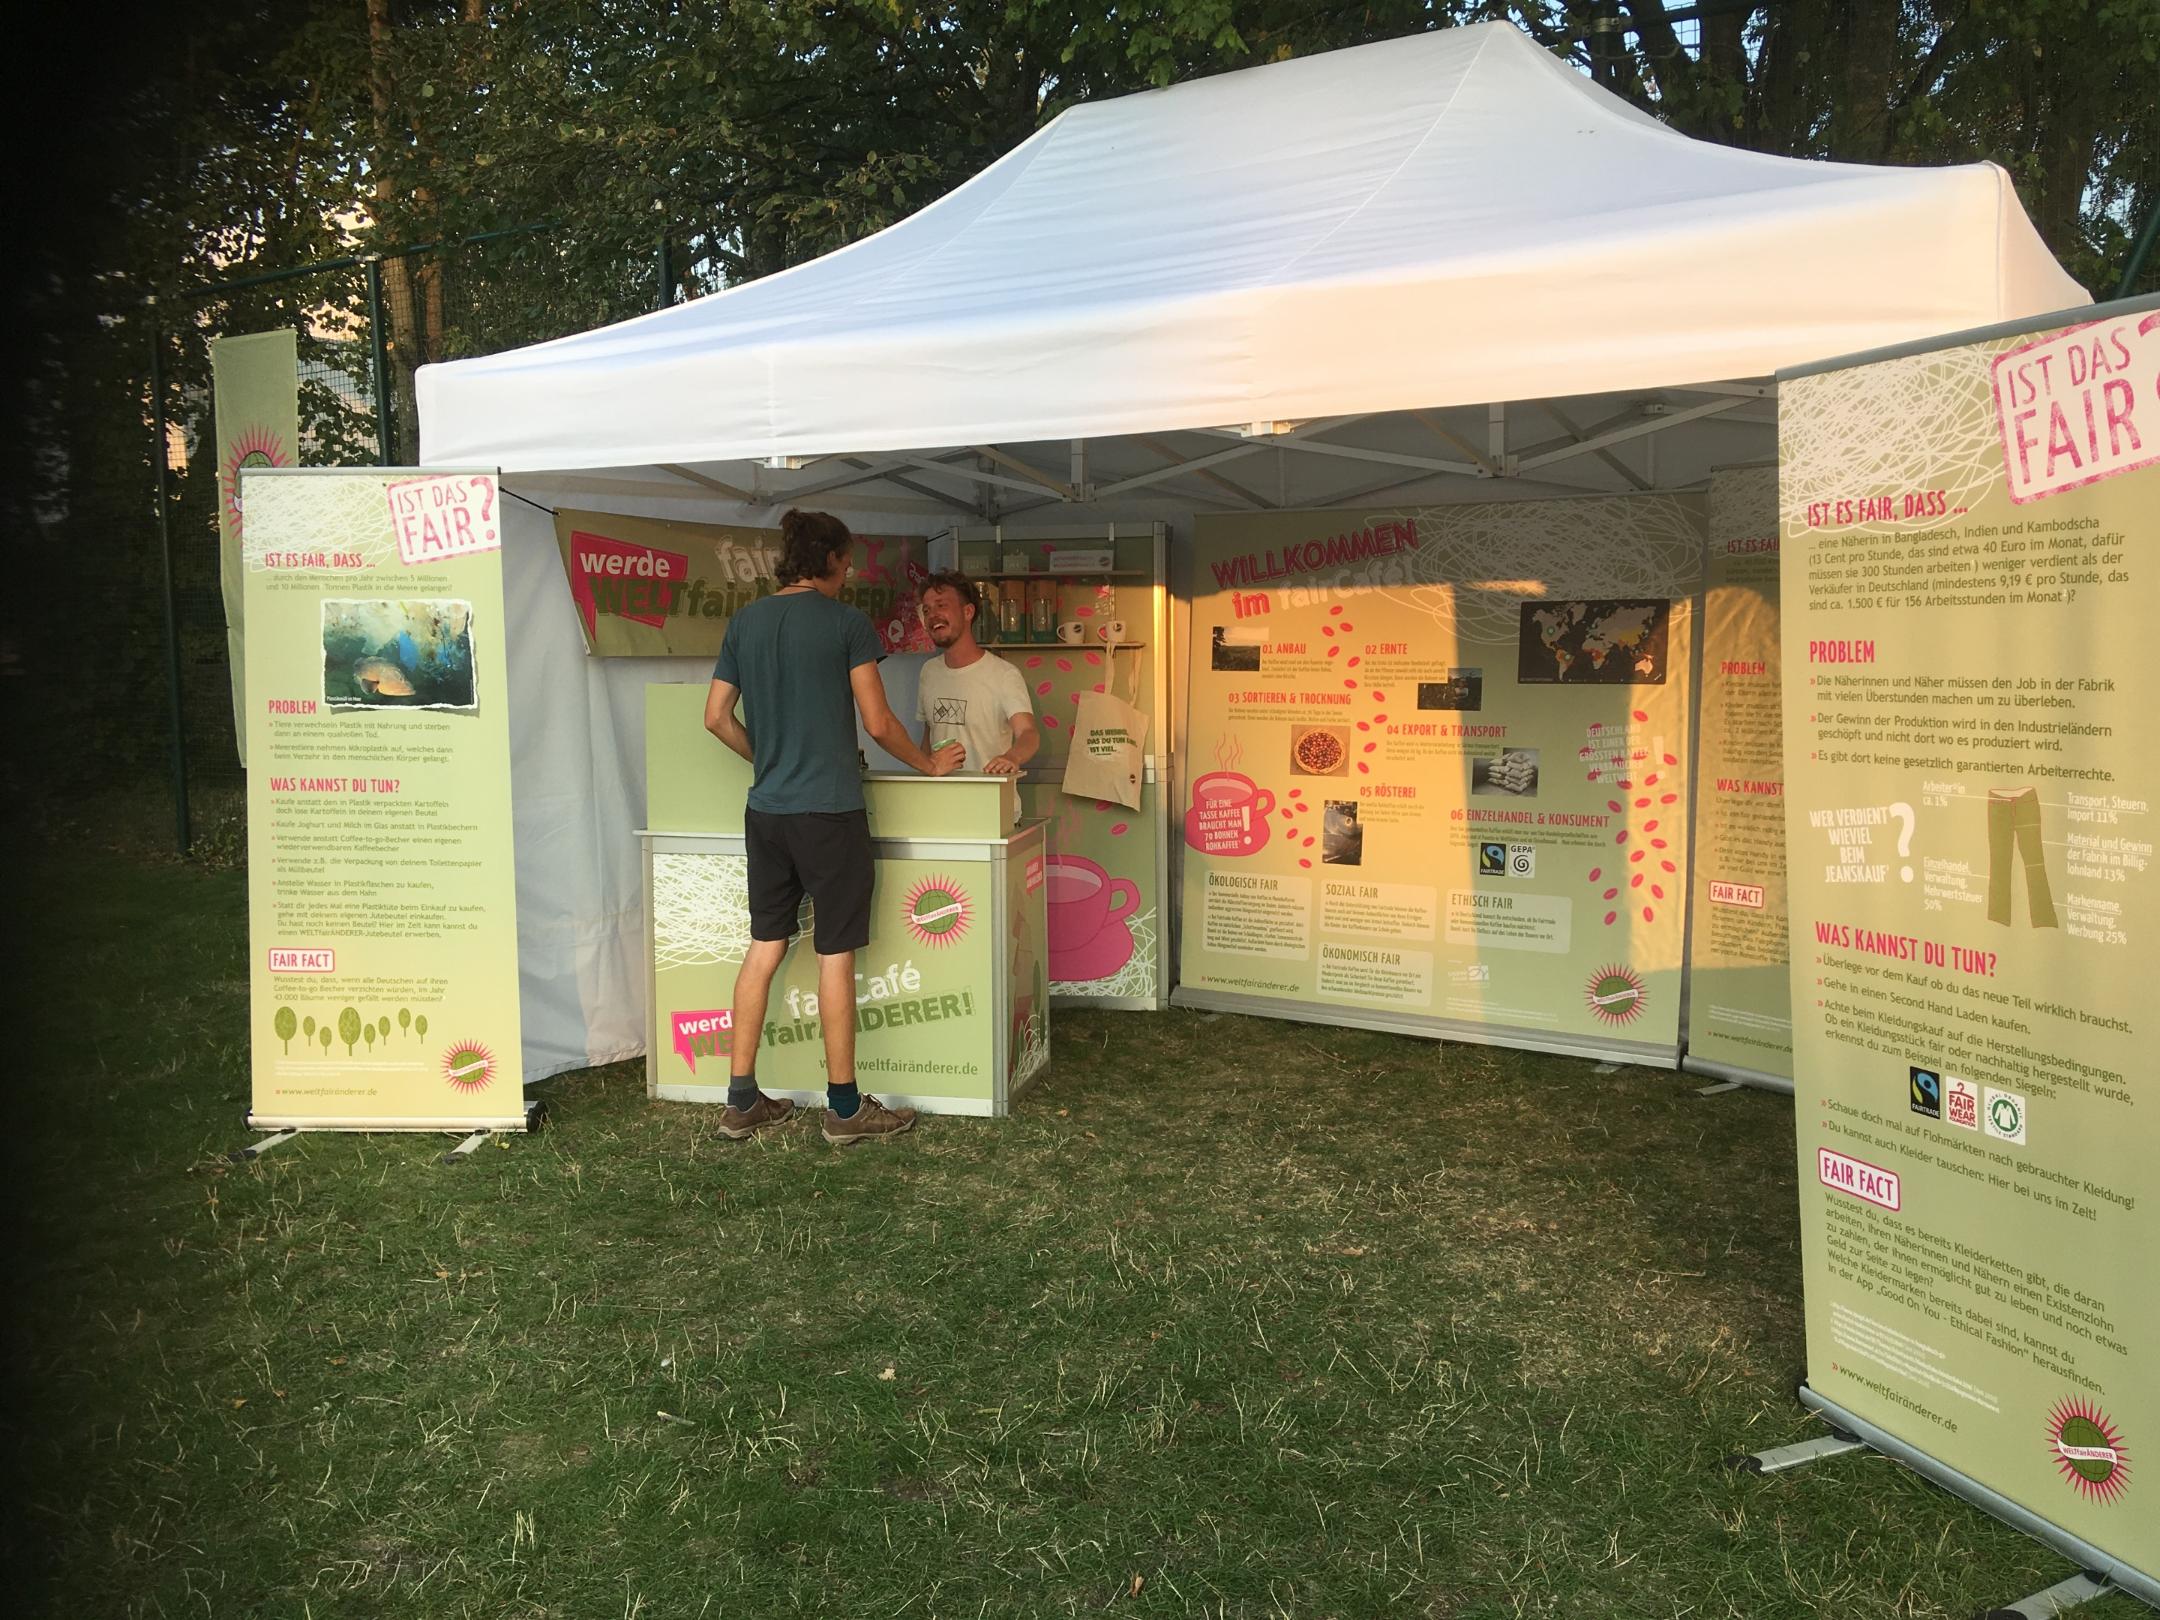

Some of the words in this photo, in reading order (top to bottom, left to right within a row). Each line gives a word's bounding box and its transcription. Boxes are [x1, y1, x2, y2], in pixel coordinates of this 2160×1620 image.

[2008, 355, 2053, 408] IST
[2067, 326, 2131, 386] DAS
[398, 490, 426, 515] IST
[432, 479, 468, 507] DAS
[1806, 501, 1830, 528] IST
[1832, 499, 1855, 525] ES
[1857, 496, 1898, 522] FAIR,
[1903, 489, 1947, 518] DASS
[1952, 505, 1968, 515] ...
[1817, 537, 1839, 549] eine
[1840, 534, 1879, 547] Näherin
[1880, 533, 1892, 544] in
[1893, 527, 1960, 545] Bangladesch,
[1963, 524, 1999, 538] Indien
[2001, 521, 2023, 535] und
[2026, 517, 2100, 533] Kambodscha
[1210, 518, 1420, 590] WILLKOMMEN
[1727, 539, 1742, 553] IST
[1745, 539, 1757, 553] ES
[265, 553, 284, 568] IST
[287, 553, 300, 568] ES
[302, 553, 329, 569] FAIR,
[333, 553, 363, 568] DASS
[579, 550, 671, 578] werde
[1232, 590, 1271, 620] im
[1262, 644, 1274, 654] 01
[1277, 643, 1307, 655] ANBAU
[1365, 644, 1377, 655] 02
[1379, 643, 1408, 655] ERNTE
[1810, 640, 1875, 664] PROBLEM
[1720, 661, 1766, 675] PROBLEM
[1816, 674, 1832, 686] Die
[1833, 674, 1889, 687] Näherinnen
[1891, 675, 1911, 687] und
[1913, 675, 1945, 688] Näher
[1947, 676, 1988, 688] müssen
[1991, 676, 2012, 689] den
[2015, 676, 2037, 689] Job
[2039, 677, 2051, 690] in
[2054, 677, 2075, 690] der
[2077, 677, 2115, 691] Fabrik
[268, 700, 317, 714] PROBLEM
[1228, 693, 1240, 703] 03
[1242, 692, 1287, 704] SORTIEREN
[1289, 692, 1296, 704] &
[1300, 692, 1352, 705] TROCKNUNG
[1387, 725, 1399, 735] 04
[1402, 724, 1438, 736] EXPORT
[1440, 724, 1448, 736] &
[1451, 724, 1507, 738] TRANSPORT
[1817, 748, 1829, 760] Es
[1830, 750, 1849, 763] gibt
[1850, 751, 1871, 764] dort
[1873, 752, 1901, 765] keine
[1902, 756, 1953, 769] gesetzlich
[1955, 760, 2024, 774] garantierten
[2026, 763, 2115, 781] Arbeiterrechte.
[270, 778, 296, 792] WAS
[300, 778, 348, 792] KANNST
[352, 779, 367, 792] DU
[370, 779, 400, 793] TUN?
[1360, 787, 1372, 797] 05
[1375, 784, 1417, 799] RÖSTEREI
[1716, 778, 1740, 793] WAS
[1205, 798, 1218, 809] FÜR
[1199, 810, 1218, 820] TASSE
[1218, 808, 1241, 818] KAFFEE
[1451, 810, 1464, 821] 06
[1466, 810, 1534, 825] EINZELHANDEL
[1538, 812, 1546, 825] &
[1548, 813, 1610, 828] KONSUMENT
[1809, 809, 1834, 828] WER
[1836, 806, 1888, 827] VERDIENT
[1198, 820, 1227, 831] BRAUCHT
[1228, 819, 1242, 828] MAN
[1828, 827, 1873, 846] WIEVIEL
[1510, 844, 1533, 854] GEPA
[1840, 846, 1865, 864] BEIM
[1208, 872, 1258, 889] ÖKOLOGISCH
[1260, 878, 1278, 891] FAIR
[1325, 883, 1356, 897] SOZIAL
[1359, 886, 1379, 899] FAIR
[1712, 885, 1734, 900] FAIR
[1737, 888, 1760, 904] FACT
[1451, 893, 1489, 908] ETHISCH
[1491, 895, 1513, 910] FAIR
[1322, 946, 1378, 964] ÖKONOMISCH
[1381, 951, 1401, 966] FAIR
[1814, 920, 1850, 948] WAS
[1854, 928, 1918, 960] KANNST
[1924, 941, 1945, 967] DU
[1951, 946, 1996, 976] TUN?
[274, 953, 298, 967] FAIR
[302, 954, 330, 968] FACT
[1822, 976, 1847, 991] Gehe
[1849, 982, 1859, 994] in
[1860, 986, 1887, 1000] einen
[1889, 991, 1925, 1009] Second
[1926, 999, 1953, 1016] Hand
[1955, 1006, 1988, 1024] Laden
[1990, 1014, 2031, 1034] kaufen.
[679, 1011, 732, 1035] werd
[1912, 1103, 1940, 1117] FAIRTRADE
[1949, 1094, 1975, 1114] FAIR
[1949, 1106, 1976, 1124] WEAR
[1823, 1156, 1854, 1192] FAIR
[1859, 1172, 1894, 1202] FACT
[1838, 1366, 1958, 1432] www.weltfairänderer.de
